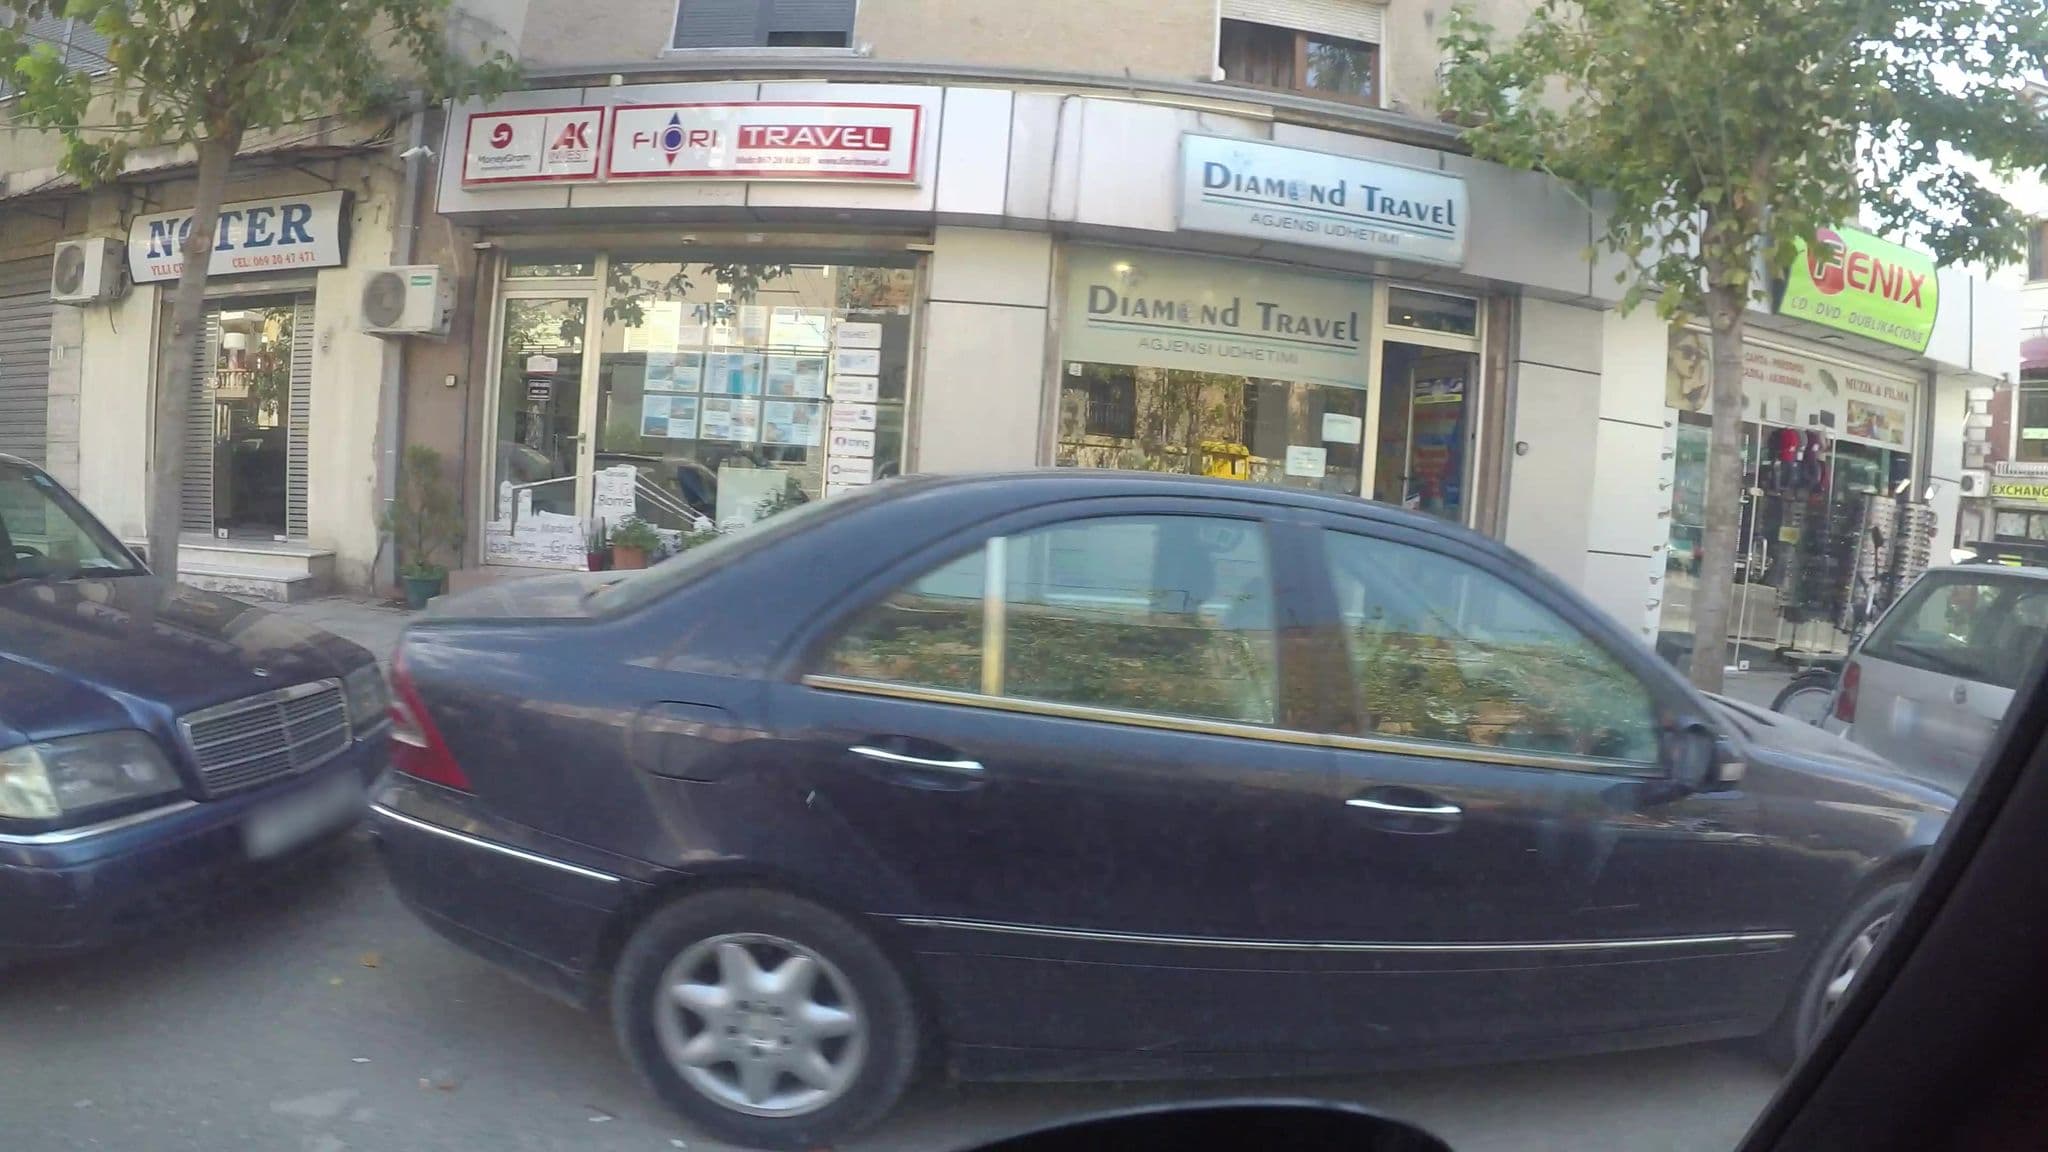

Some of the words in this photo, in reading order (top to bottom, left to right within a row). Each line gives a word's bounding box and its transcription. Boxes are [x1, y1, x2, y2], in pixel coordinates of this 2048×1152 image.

[743, 126, 886, 148] TRAVEL
[1249, 212, 1321, 233] AGJENSI
[1324, 222, 1400, 245] UDHETIMI
[1816, 302, 1841, 319] DVD
[1138, 338, 1211, 355] AGJENSI
[1218, 346, 1298, 365] UDHETIMI
